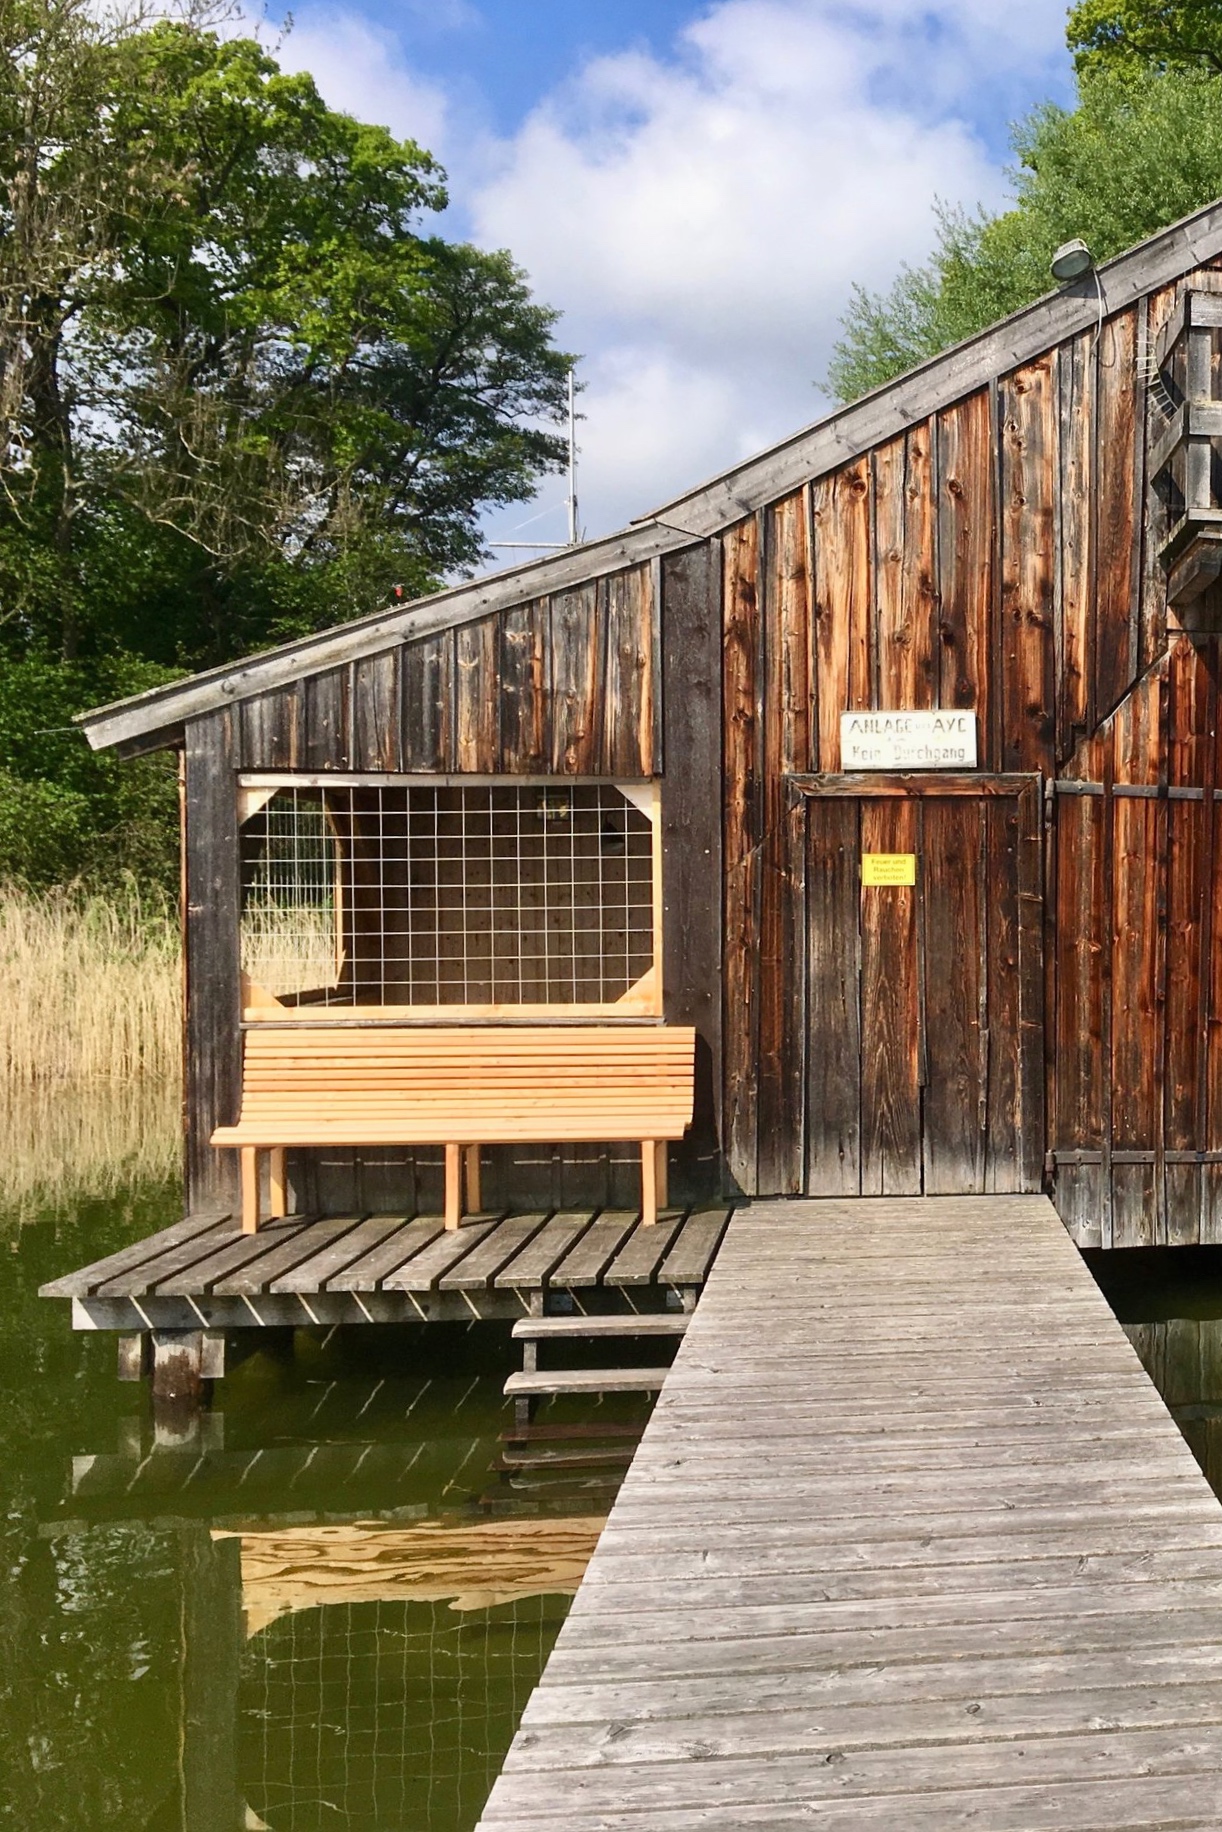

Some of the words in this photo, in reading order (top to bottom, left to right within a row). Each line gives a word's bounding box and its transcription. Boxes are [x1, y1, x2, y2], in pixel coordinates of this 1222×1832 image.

[848, 718, 912, 734] ANLAGE
[931, 717, 967, 733] AYC
[852, 745, 881, 760] Kein
